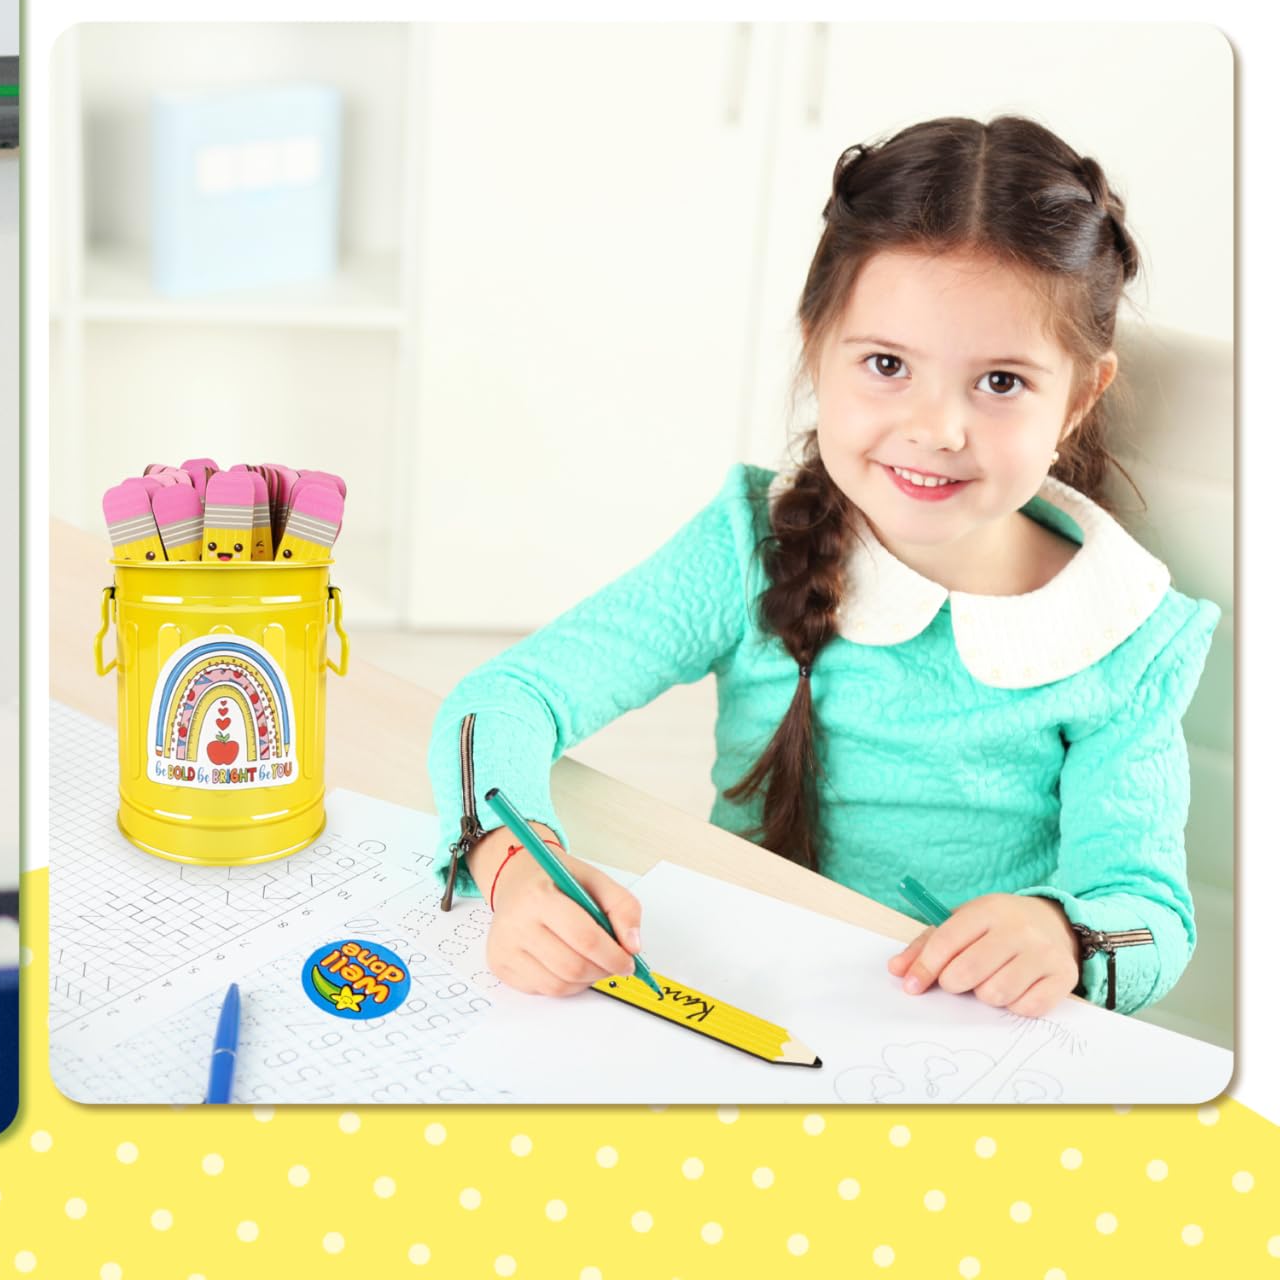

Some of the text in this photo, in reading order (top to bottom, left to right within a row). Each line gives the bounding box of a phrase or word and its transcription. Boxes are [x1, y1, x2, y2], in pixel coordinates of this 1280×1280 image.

[155, 760, 293, 784] be BOLD be BRIGHT be YOU
[320, 948, 391, 1005] well
[340, 941, 406, 984] done
